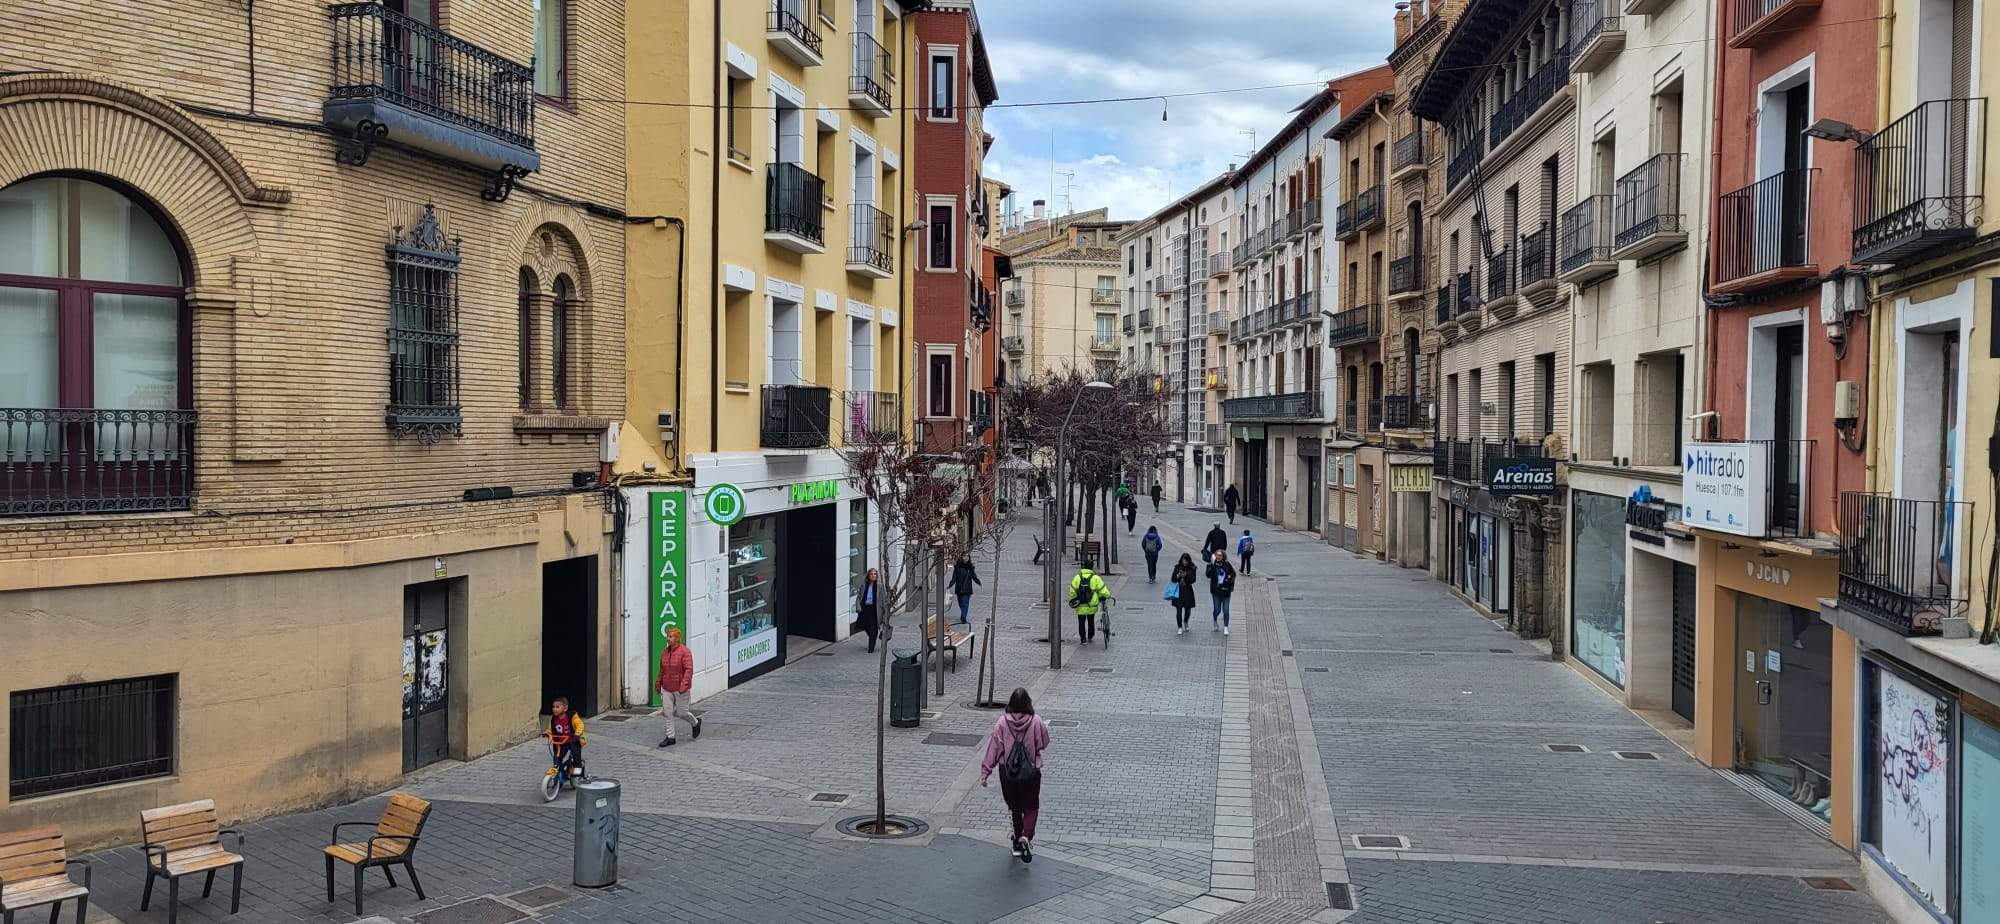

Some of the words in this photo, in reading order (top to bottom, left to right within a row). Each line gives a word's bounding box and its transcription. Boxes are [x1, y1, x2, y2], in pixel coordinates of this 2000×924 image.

[1696, 449, 1745, 479] hitradio
[1393, 467, 1430, 487] ASCASO
[1492, 468, 1554, 483] Arenas
[1696, 481, 1716, 495] Huesca
[659, 499, 678, 648] REPARAC
[1756, 563, 1780, 585] JCN
[737, 638, 770, 664] REPARACIONES
